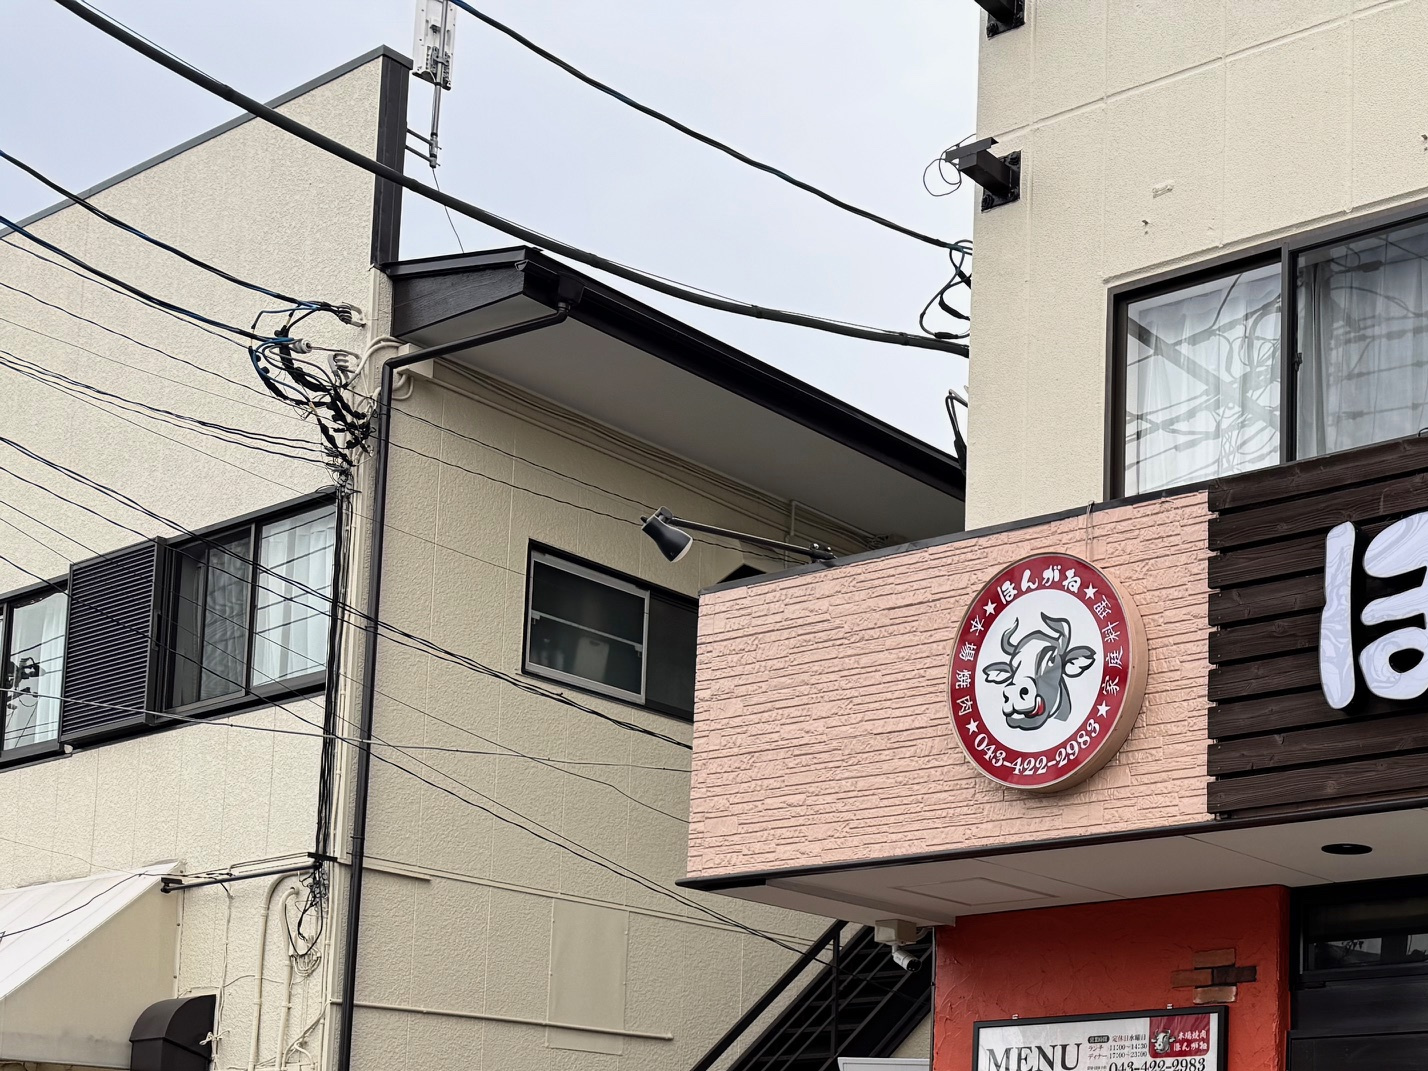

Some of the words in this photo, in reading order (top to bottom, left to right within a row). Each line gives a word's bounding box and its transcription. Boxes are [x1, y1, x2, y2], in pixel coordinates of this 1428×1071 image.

[998, 565, 1082, 604] ほんがね
[955, 615, 985, 716] 本場焼肉
[974, 718, 1101, 776] 043-422-2983
